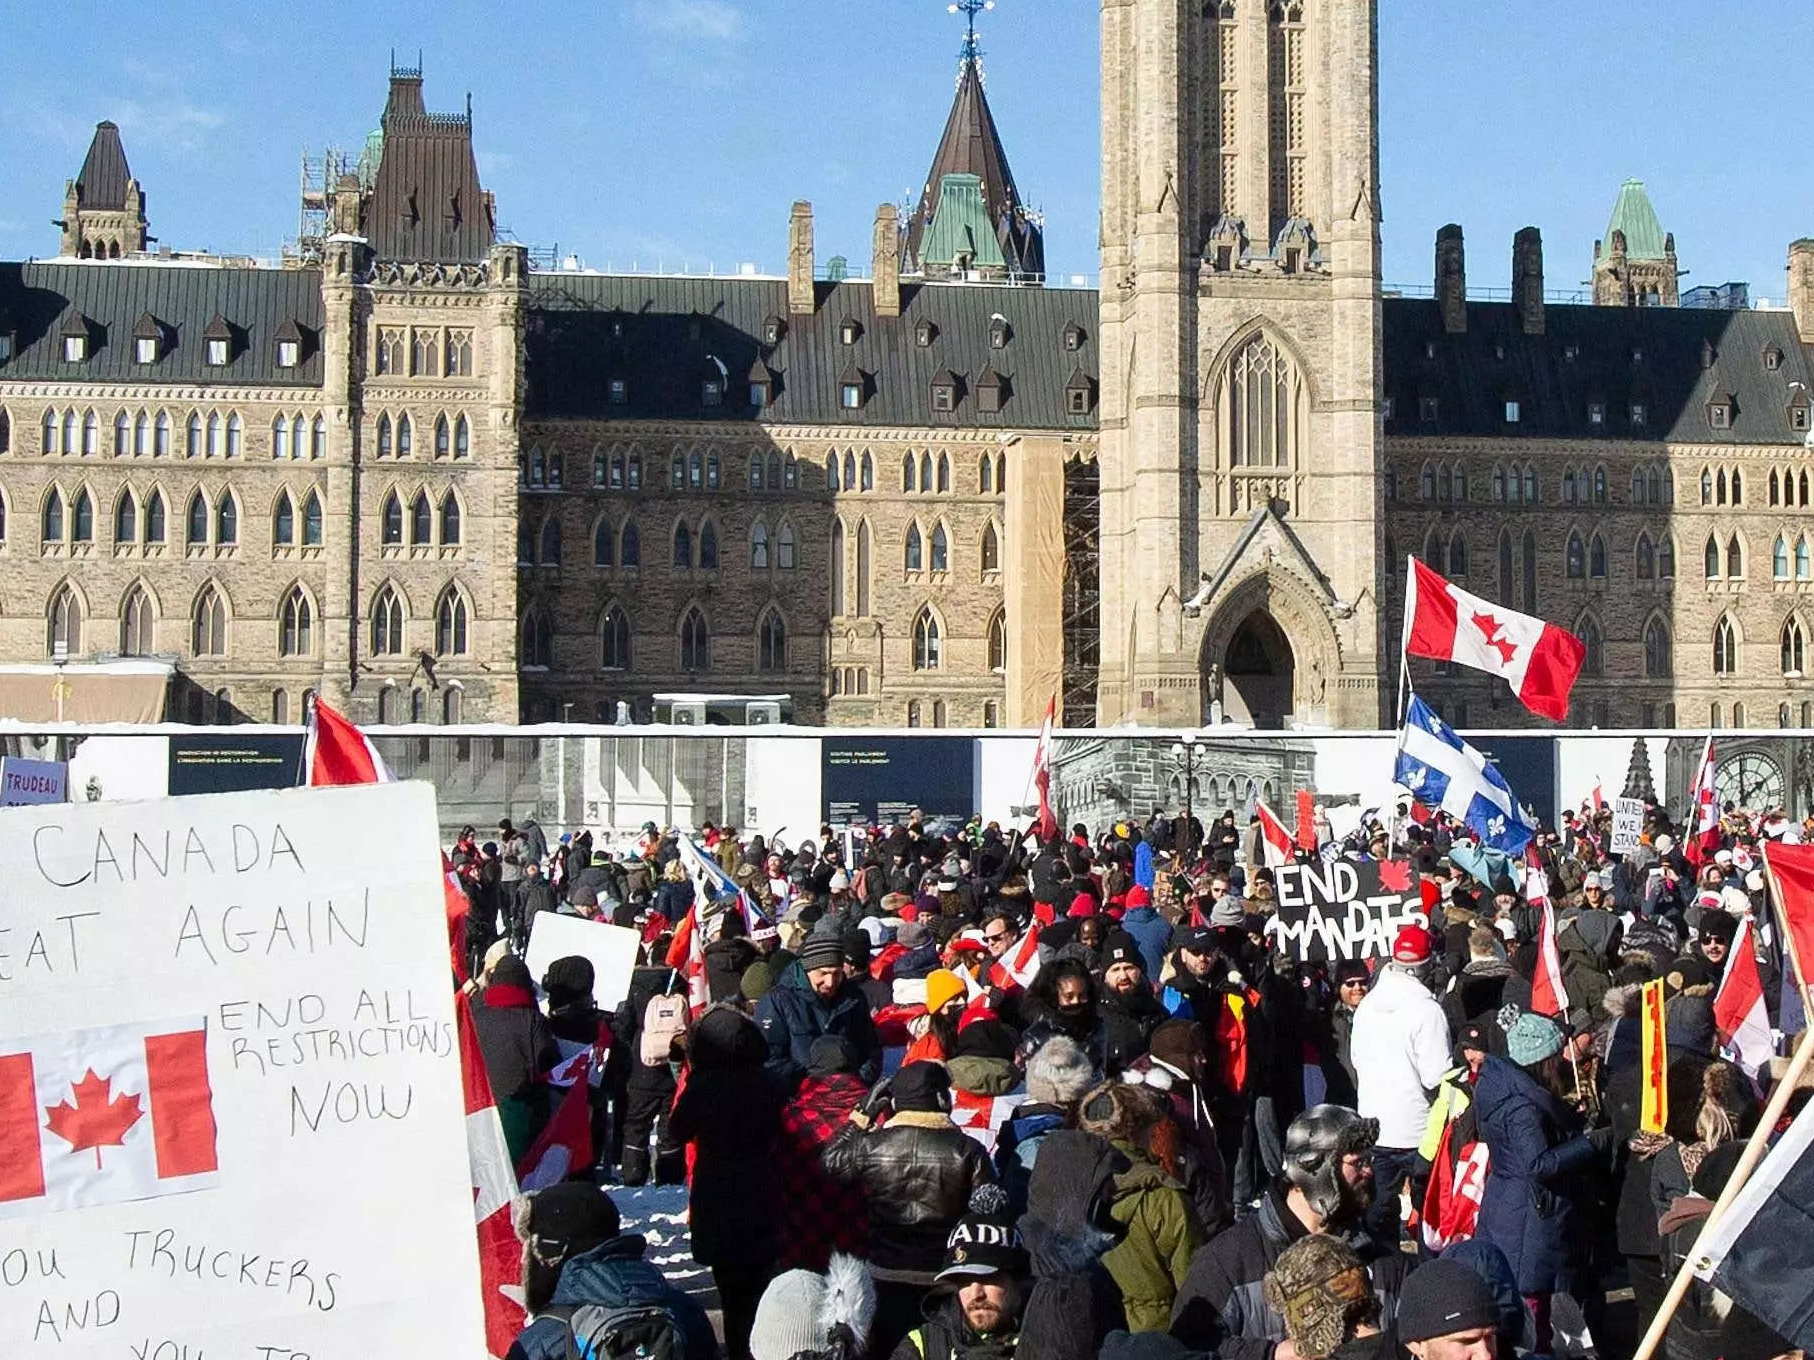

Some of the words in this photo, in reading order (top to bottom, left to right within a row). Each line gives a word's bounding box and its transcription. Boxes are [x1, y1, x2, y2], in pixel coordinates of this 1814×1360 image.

[7, 772, 59, 795] TRUDEAU
[33, 823, 306, 887] CANADA
[1275, 862, 1359, 907] END
[175, 888, 370, 965] AGAIN
[219, 993, 326, 1031] END
[353, 989, 430, 1023] ALL
[231, 1021, 454, 1077] RESTRICTIONS
[291, 1084, 414, 1138] NOW
[124, 1228, 342, 1312] TRUCKERS
[33, 1290, 121, 1342] AND
